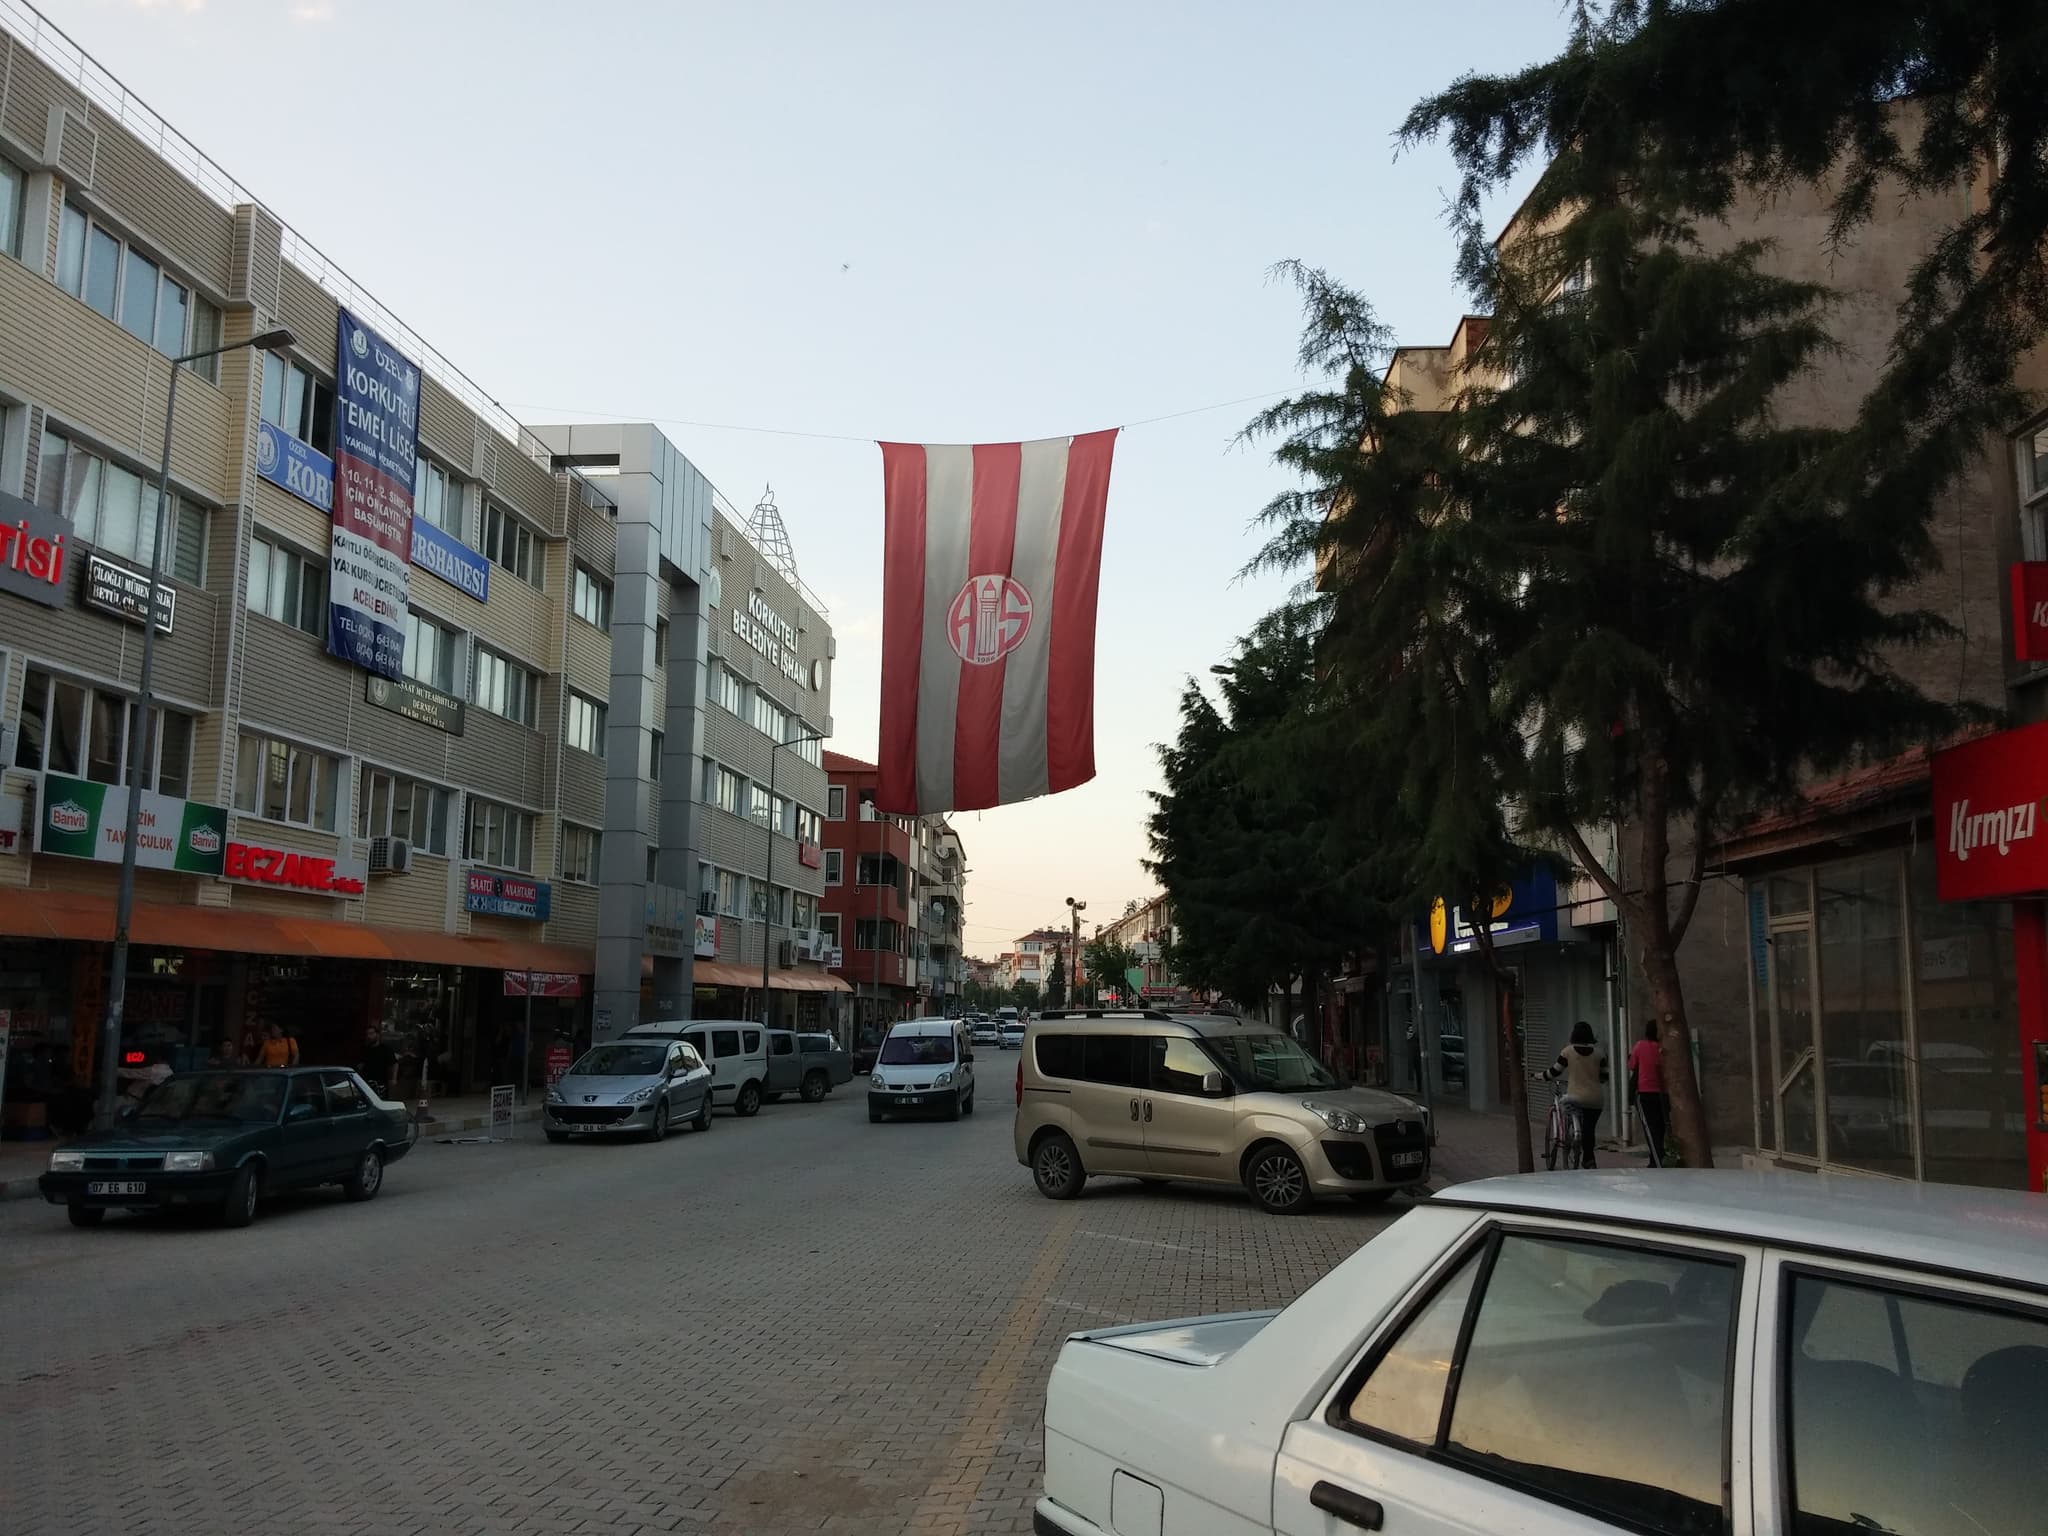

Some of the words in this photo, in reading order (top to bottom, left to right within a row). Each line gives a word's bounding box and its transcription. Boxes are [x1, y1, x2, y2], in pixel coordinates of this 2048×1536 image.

[374, 343, 402, 381] ÖZEL
[347, 363, 416, 432] KORKUTELİ
[338, 395, 386, 444] TEMEL
[344, 435, 377, 459] YAKINDA
[287, 455, 335, 509] KOR
[345, 482, 365, 505] İÇİN
[748, 590, 799, 655] KORKUTELİ
[732, 608, 778, 667] BELEDİYE
[780, 643, 808, 690] İŞHANI
[53, 809, 87, 829] Banvit
[191, 833, 218, 850] Banvit
[225, 841, 336, 890] ECZANE
[470, 877, 494, 896] SAATÇİ
[93, 1183, 104, 1193] 07
